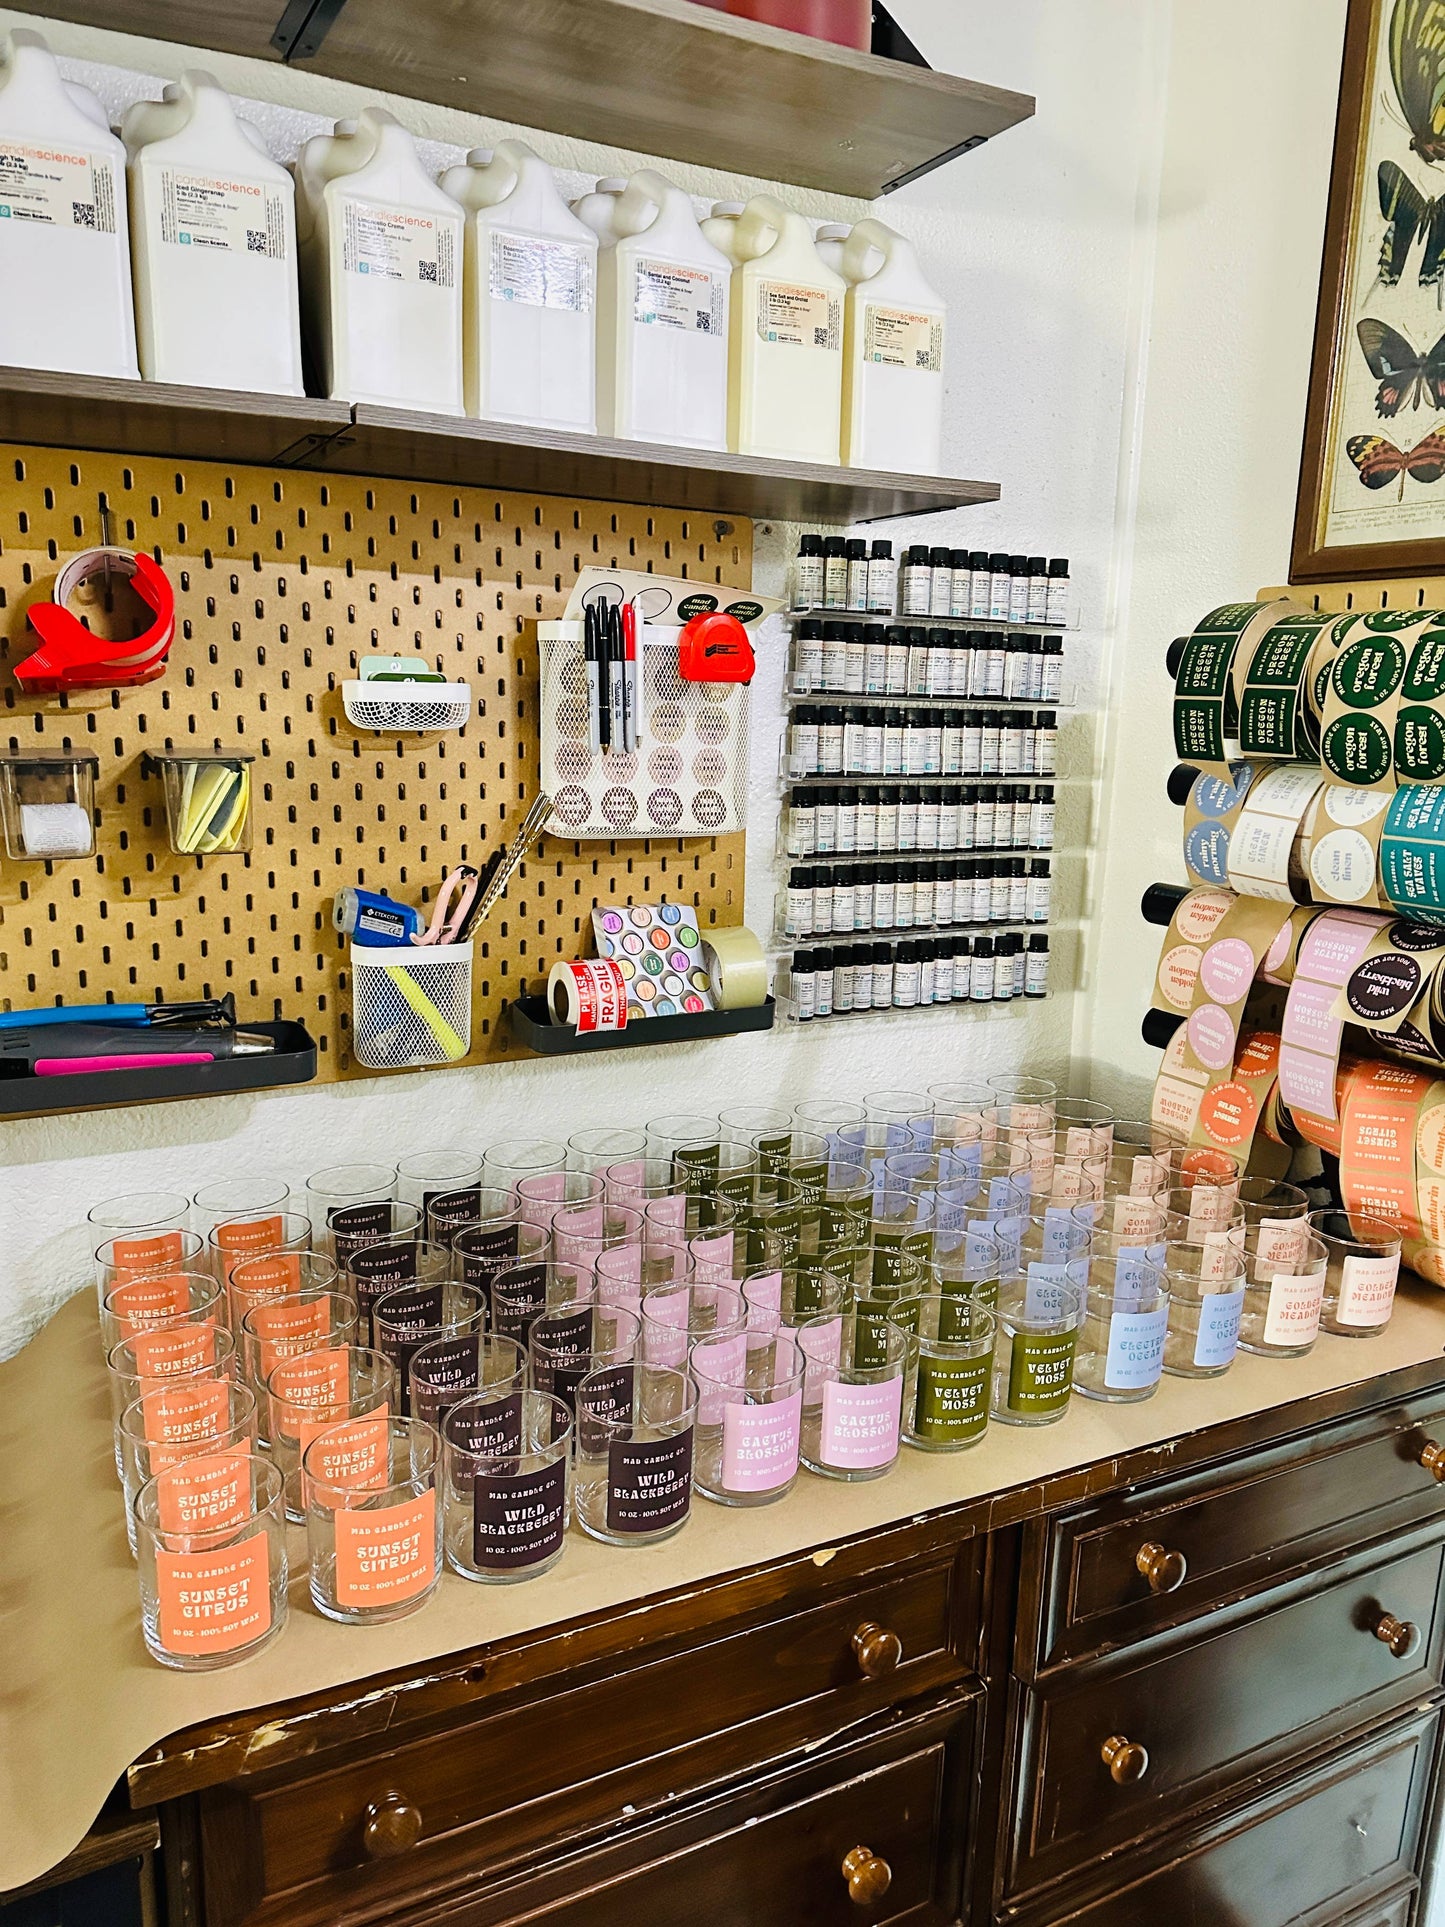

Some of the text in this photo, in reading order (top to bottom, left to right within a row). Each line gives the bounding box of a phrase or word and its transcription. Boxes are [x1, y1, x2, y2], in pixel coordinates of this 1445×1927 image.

[0, 144, 86, 165] andlescience
[176, 175, 260, 195] candlescience
[191, 187, 225, 196] Gingersnap
[357, 208, 432, 228] candlescience
[648, 264, 708, 282] candlescience
[770, 286, 825, 299] candlescience
[1267, 635, 1290, 675] OREGON
[1275, 635, 1299, 675] FOREST
[1413, 642, 1435, 685] oregon
[1193, 644, 1210, 687] OREGON
[1201, 645, 1217, 686] FOREST
[1353, 648, 1372, 692] oregon
[1364, 652, 1384, 690] forest
[1190, 710, 1199, 751] OREGON
[1198, 711, 1206, 751] FOREST
[1258, 699, 1268, 743] OREGON
[1266, 700, 1276, 743] FOREST
[1346, 728, 1356, 771] oregon
[1357, 732, 1368, 769] forest
[1405, 722, 1416, 767] oregon
[1417, 726, 1429, 765] forest
[1418, 786, 1442, 824] WAVES
[1407, 814, 1420, 829] SEA
[1200, 839, 1209, 867] rainy
[1209, 831, 1221, 876] morning
[1248, 828, 1262, 863] CLEAN
[1258, 832, 1271, 863] LINEN
[1331, 851, 1340, 881] clean
[1342, 853, 1352, 880] linen
[1403, 849, 1416, 898] SEA SALT
[1414, 856, 1425, 894] WAVES
[375, 911, 398, 920] ETEKCITY
[1190, 912, 1217, 922] golden
[1191, 903, 1225, 914] meadow
[1314, 949, 1349, 962] CACTUS
[1315, 939, 1356, 955] BLOSSOM
[1212, 957, 1243, 976] blossom
[1213, 969, 1237, 984] cactus
[1358, 969, 1414, 991] blackberry
[1367, 984, 1390, 996] wild
[576, 976, 590, 1013] PLEASE
[598, 965, 613, 1024] FRAGILE
[1295, 1014, 1329, 1030] CACTUS
[1197, 1023, 1226, 1044] blossom
[1199, 1035, 1221, 1050] cactus
[1213, 1110, 1240, 1125] sunset
[1217, 1101, 1241, 1115] citrus
[1357, 1136, 1397, 1148] SUNSET
[1359, 1126, 1396, 1138] CITRUS
[1361, 1197, 1399, 1209] CITRUS
[1428, 1186, 1439, 1240] mandarin
[1352, 1289, 1393, 1301] MEADOW
[1358, 1280, 1394, 1291] GOLDEN
[1286, 1298, 1320, 1309] GOLDEN
[1043, 1346, 1066, 1354] CANDLE
[1129, 1348, 1160, 1360] OCEAN
[950, 1370, 977, 1378] CANDLE
[1028, 1357, 1071, 1374] VELVET
[1035, 1371, 1065, 1385] MOSS
[285, 1379, 337, 1398] SUNSET
[934, 1383, 983, 1398] VELVET
[857, 1397, 884, 1407] CANDLE
[942, 1398, 976, 1410] MOSS
[758, 1416, 785, 1425] CANDLE
[840, 1412, 891, 1426] CACTUS
[962, 1416, 973, 1424] SOY
[974, 1412, 984, 1422] WAX
[742, 1428, 793, 1446] CACTUS
[834, 1422, 894, 1437] BLOSSOM
[468, 1431, 504, 1450] WILD
[736, 1437, 795, 1460] BLOSSOM
[323, 1443, 377, 1466] SUNSET
[644, 1452, 674, 1464] CANDLE
[172, 1477, 191, 1485] MAD
[194, 1470, 228, 1484] CANDLE
[325, 1458, 375, 1478] CITRUS
[511, 1485, 543, 1499] CANDLE
[546, 1479, 557, 1490] CO.
[614, 1473, 691, 1499] BLACKBERRY
[637, 1470, 675, 1488] WILD
[178, 1479, 238, 1508] SUNSET
[181, 1495, 237, 1521] CITRUS
[504, 1504, 545, 1522] WILD
[351, 1513, 425, 1535] MAD CANDLE CO.
[479, 1505, 562, 1535] BLACKBERRY
[357, 1532, 421, 1559] SUNSET
[494, 1546, 505, 1554] OZ
[511, 1543, 528, 1553] 100%
[529, 1539, 542, 1549] SOY
[543, 1531, 557, 1543] WAX
[172, 1557, 255, 1578] MAD CANDLE CO.
[359, 1548, 419, 1573] CITRUS
[179, 1577, 250, 1604] SUNSET
[182, 1594, 249, 1618] CITRUS
[201, 1626, 221, 1636] 100%
[223, 1622, 240, 1634] SOY
[241, 1613, 260, 1628] WAX
